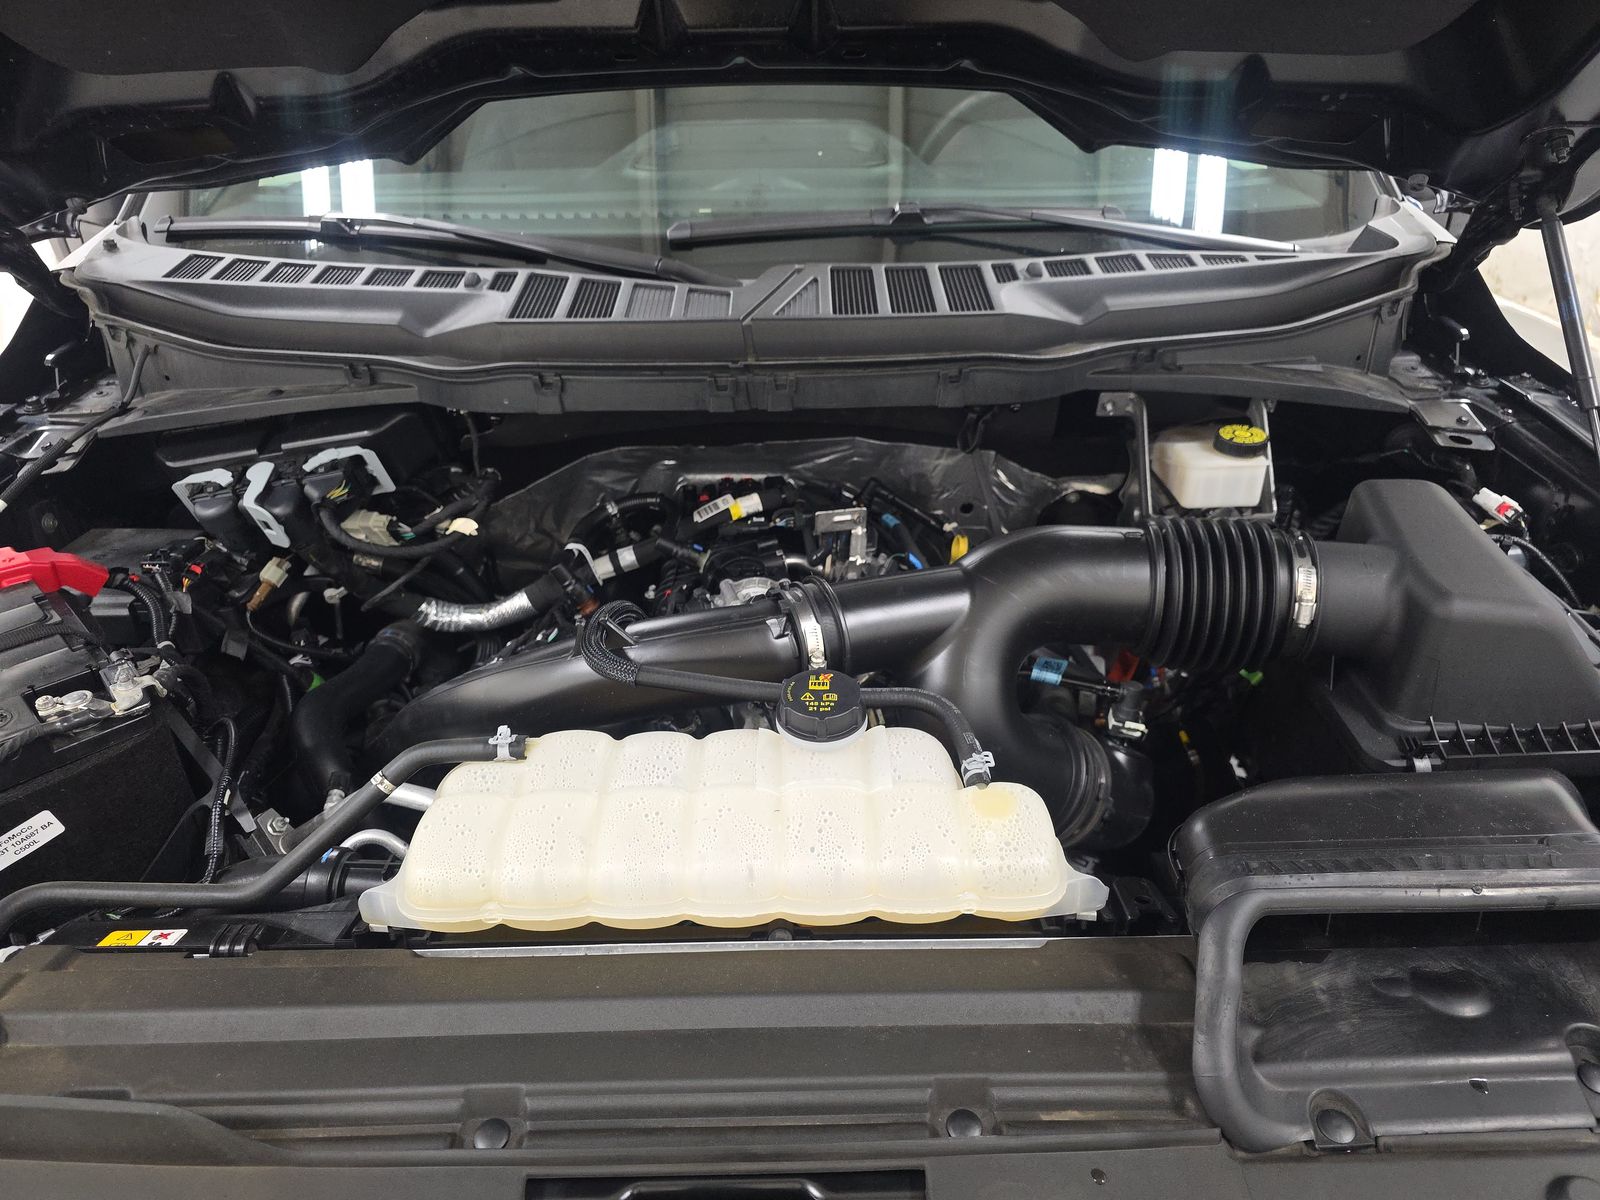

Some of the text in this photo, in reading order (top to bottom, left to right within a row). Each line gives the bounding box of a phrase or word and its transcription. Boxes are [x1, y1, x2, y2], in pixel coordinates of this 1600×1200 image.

[40, 821, 54, 831] BA
[0, 825, 33, 848] FoMoCo
[14, 839, 40, 856] C500L
